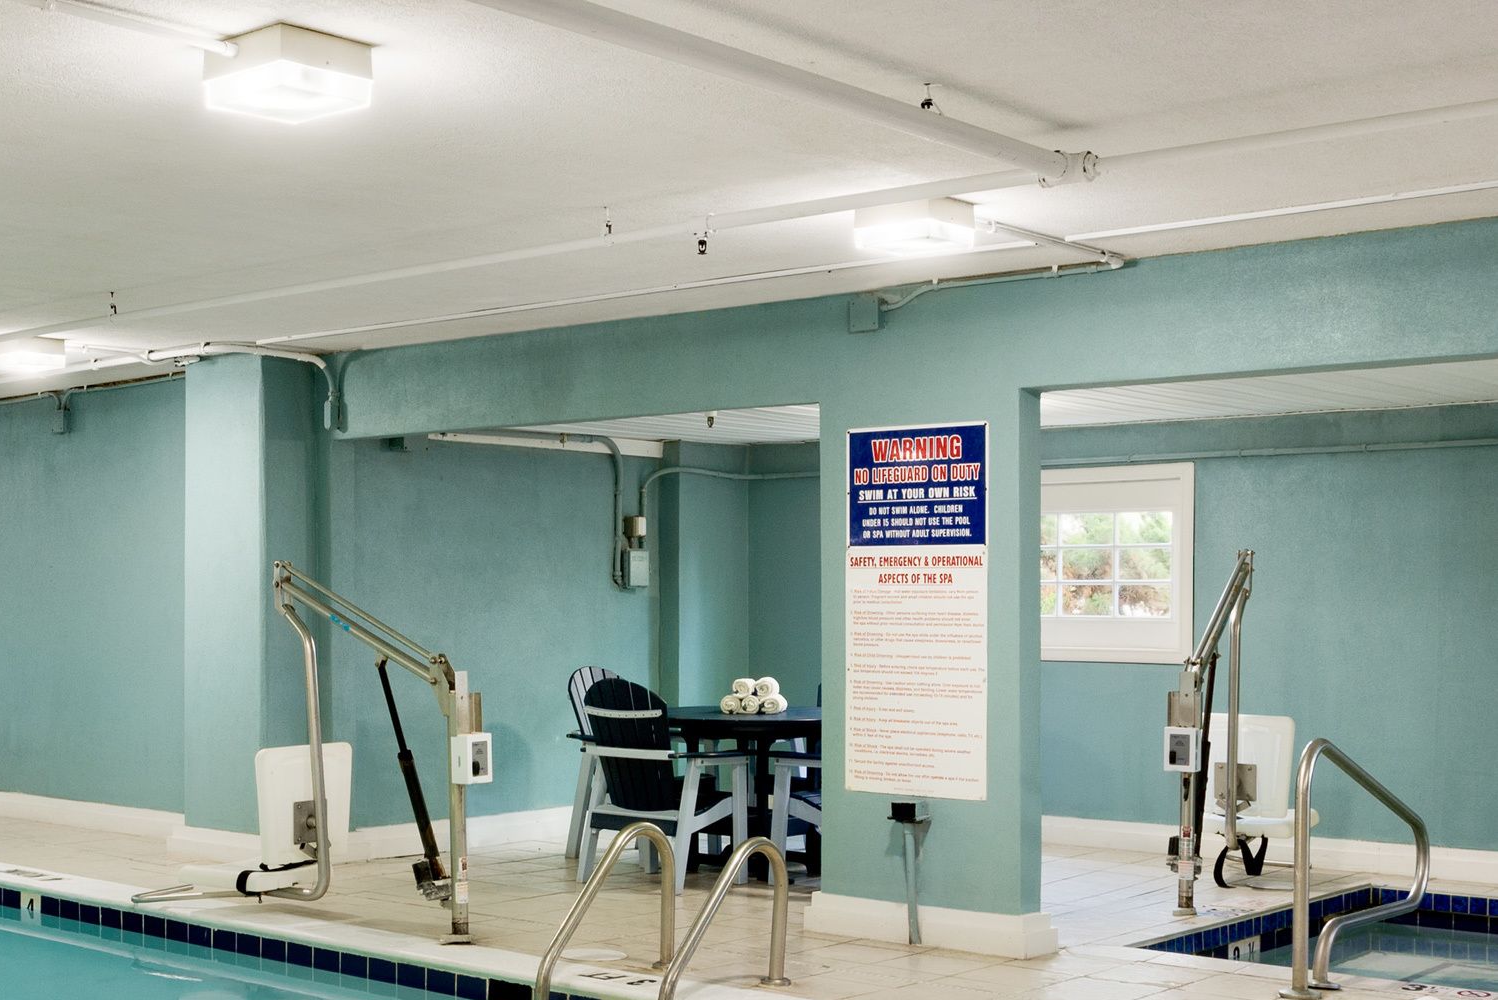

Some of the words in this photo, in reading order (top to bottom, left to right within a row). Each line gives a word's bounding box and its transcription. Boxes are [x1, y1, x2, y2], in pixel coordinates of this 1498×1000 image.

[871, 434, 962, 463] WARNING
[854, 468, 869, 485] NO
[872, 465, 928, 485] LIFEGUARD
[932, 464, 947, 481] ON
[951, 463, 980, 481] DUTY
[859, 489, 883, 500] SWIM
[887, 489, 898, 499] AT
[902, 488, 924, 499] YOUR
[928, 487, 950, 498] OWN
[953, 486, 976, 497] RISK
[869, 506, 877, 515] DO
[879, 506, 890, 515] NOT
[891, 506, 908, 515] SWIM
[909, 505, 930, 514] ALONE.
[934, 504, 963, 514] CHILDREN
[862, 519, 882, 528] UNDER
[883, 519, 889, 527] 15
[891, 518, 913, 527] SHOULD
[915, 518, 927, 526] NOT
[928, 517, 940, 526] USE
[942, 517, 953, 525] THE
[955, 516, 970, 525] POOL
[863, 530, 871, 539] OR
[872, 530, 883, 539] SPA
[885, 530, 910, 539] WITHOUT
[912, 529, 929, 538] ADULT
[931, 528, 972, 538] SUPERVISION.
[850, 556, 877, 568] SAFETY,
[879, 556, 922, 567] EMERGENCY
[924, 556, 929, 567] &
[932, 555, 983, 567] OPERATIONAL
[878, 573, 908, 584] ASPECTS
[911, 573, 921, 584] OF
[923, 573, 937, 584] THE
[939, 573, 953, 584] SPA
